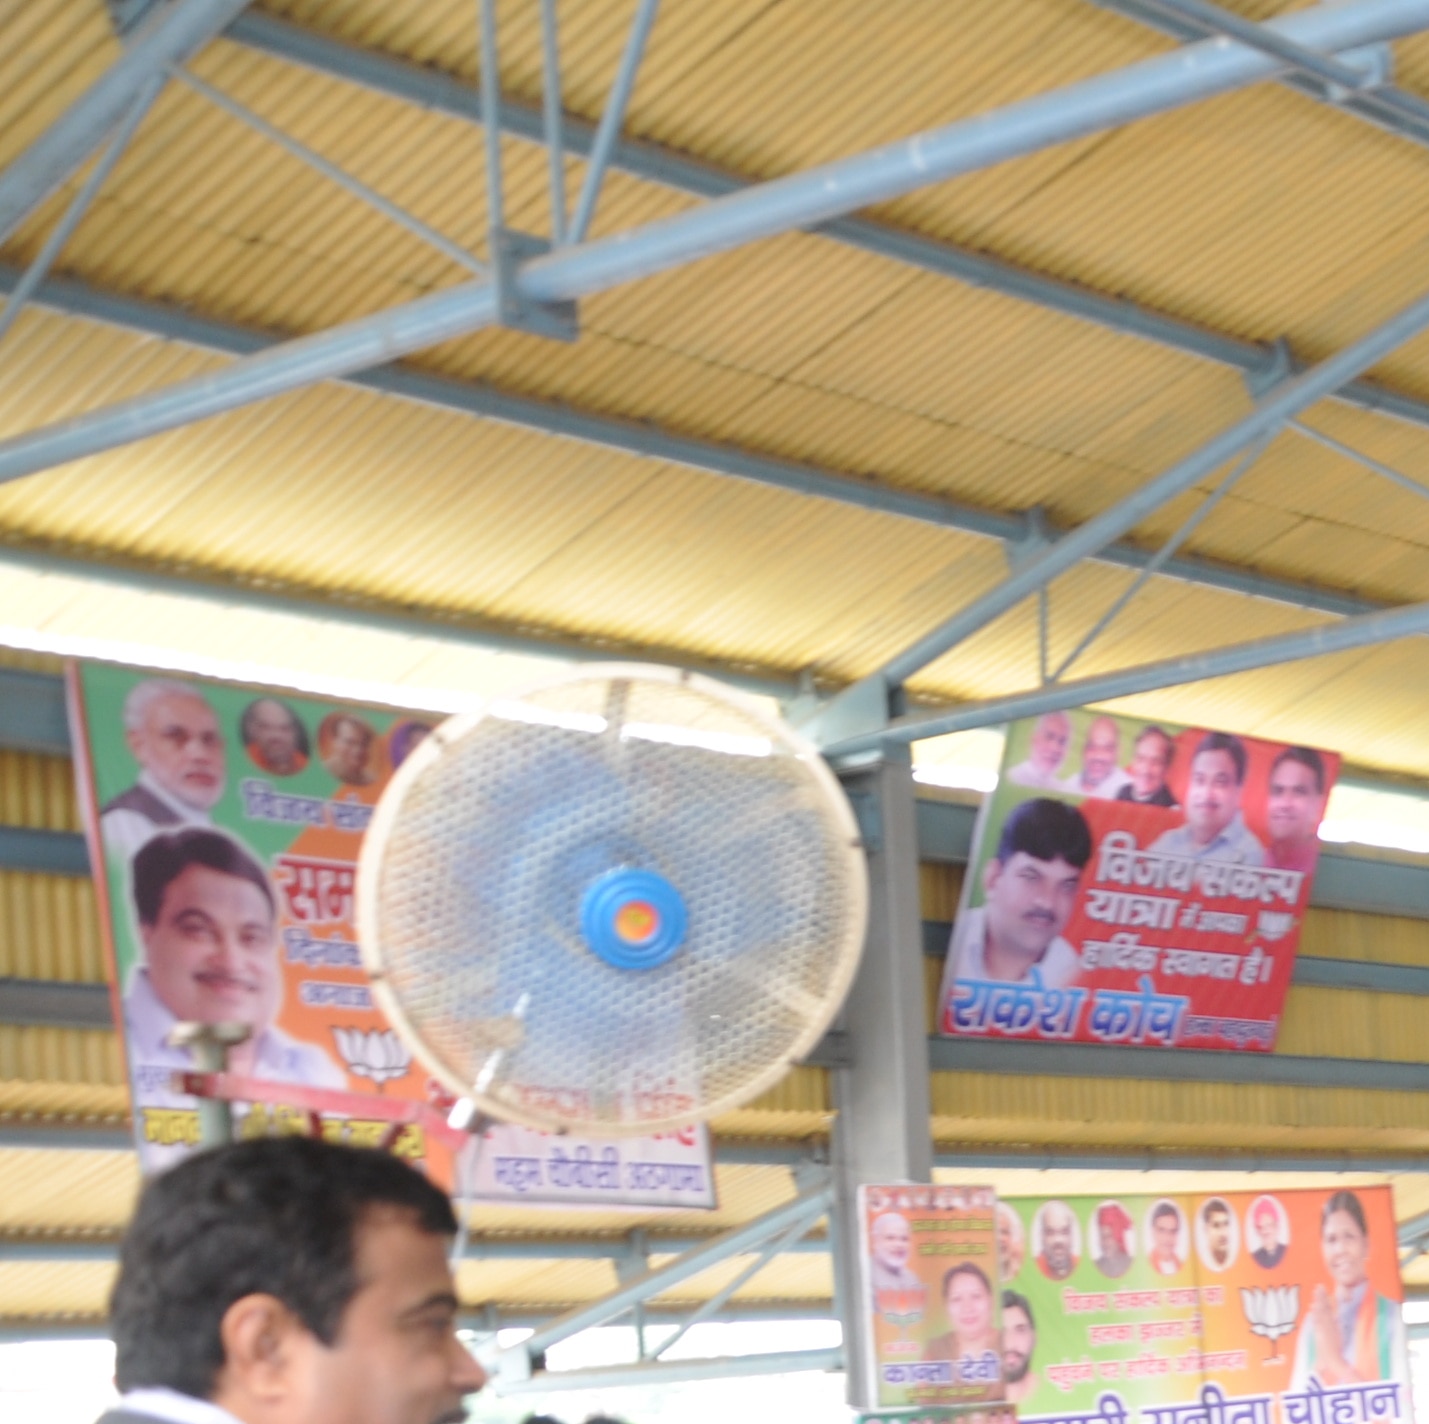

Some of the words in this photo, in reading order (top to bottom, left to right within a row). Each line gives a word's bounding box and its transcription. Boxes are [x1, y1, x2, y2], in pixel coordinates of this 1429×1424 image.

[1096, 831, 1197, 892] विजय
[1200, 857, 1305, 906] संकल्प
[1084, 888, 1183, 931] यात्रा
[1080, 931, 1162, 972] हार्दिक
[1161, 948, 1242, 980] स्वागत
[951, 966, 1089, 1037] राकेश
[1090, 974, 1191, 1045] कोच
[1063, 1287, 1108, 1314] विजय
[957, 1350, 1001, 1383] देवी
